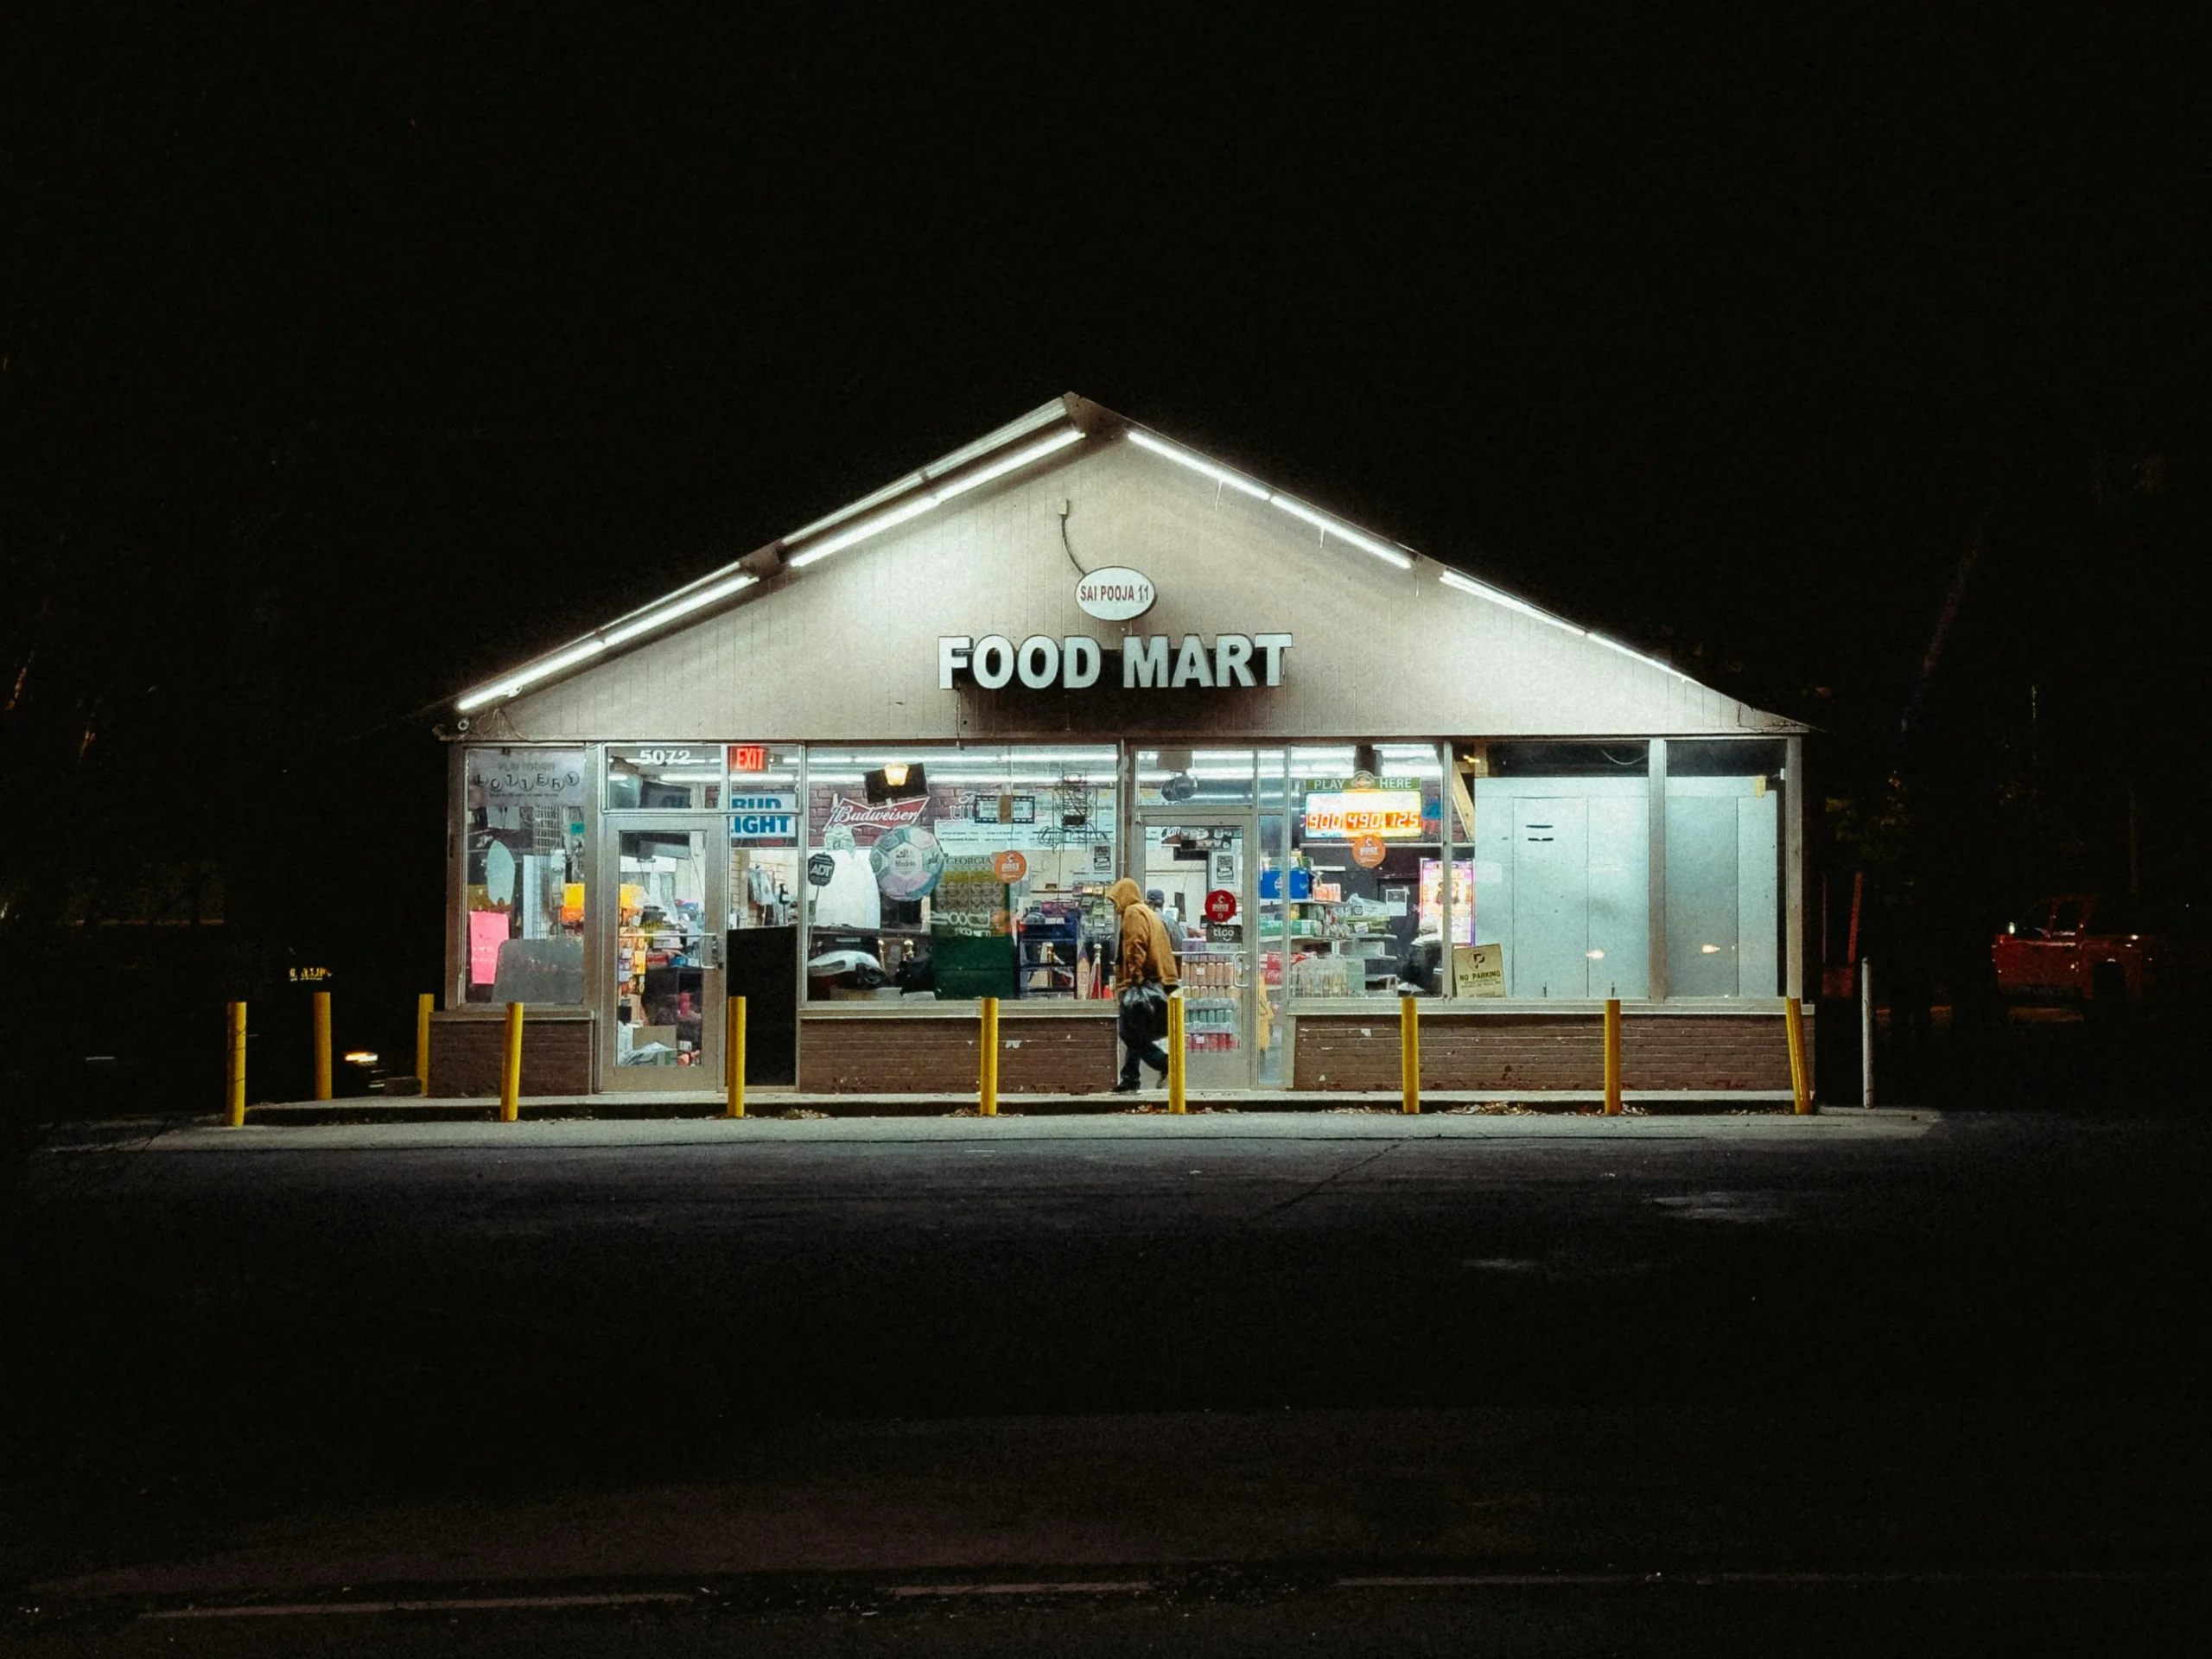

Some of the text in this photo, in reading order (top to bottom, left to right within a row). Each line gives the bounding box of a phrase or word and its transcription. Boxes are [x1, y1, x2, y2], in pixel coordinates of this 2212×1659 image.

[1080, 585, 1149, 601] SAI POOJA 11
[938, 633, 1293, 690] FOOD MART
[639, 750, 691, 765] 5072
[735, 747, 764, 770] EXIT
[474, 772, 580, 791] LOTTERY
[1313, 779, 1345, 790] PLAY
[1380, 779, 1412, 789] HERE
[831, 805, 919, 823] Budweiser
[1309, 812, 1419, 830] 900 490 125
[731, 817, 790, 834] IGHT
[946, 856, 992, 866] GEORGIA
[810, 865, 833, 877] ADT
[1213, 928, 1234, 938] tigo
[1472, 970, 1501, 980] PARKING
